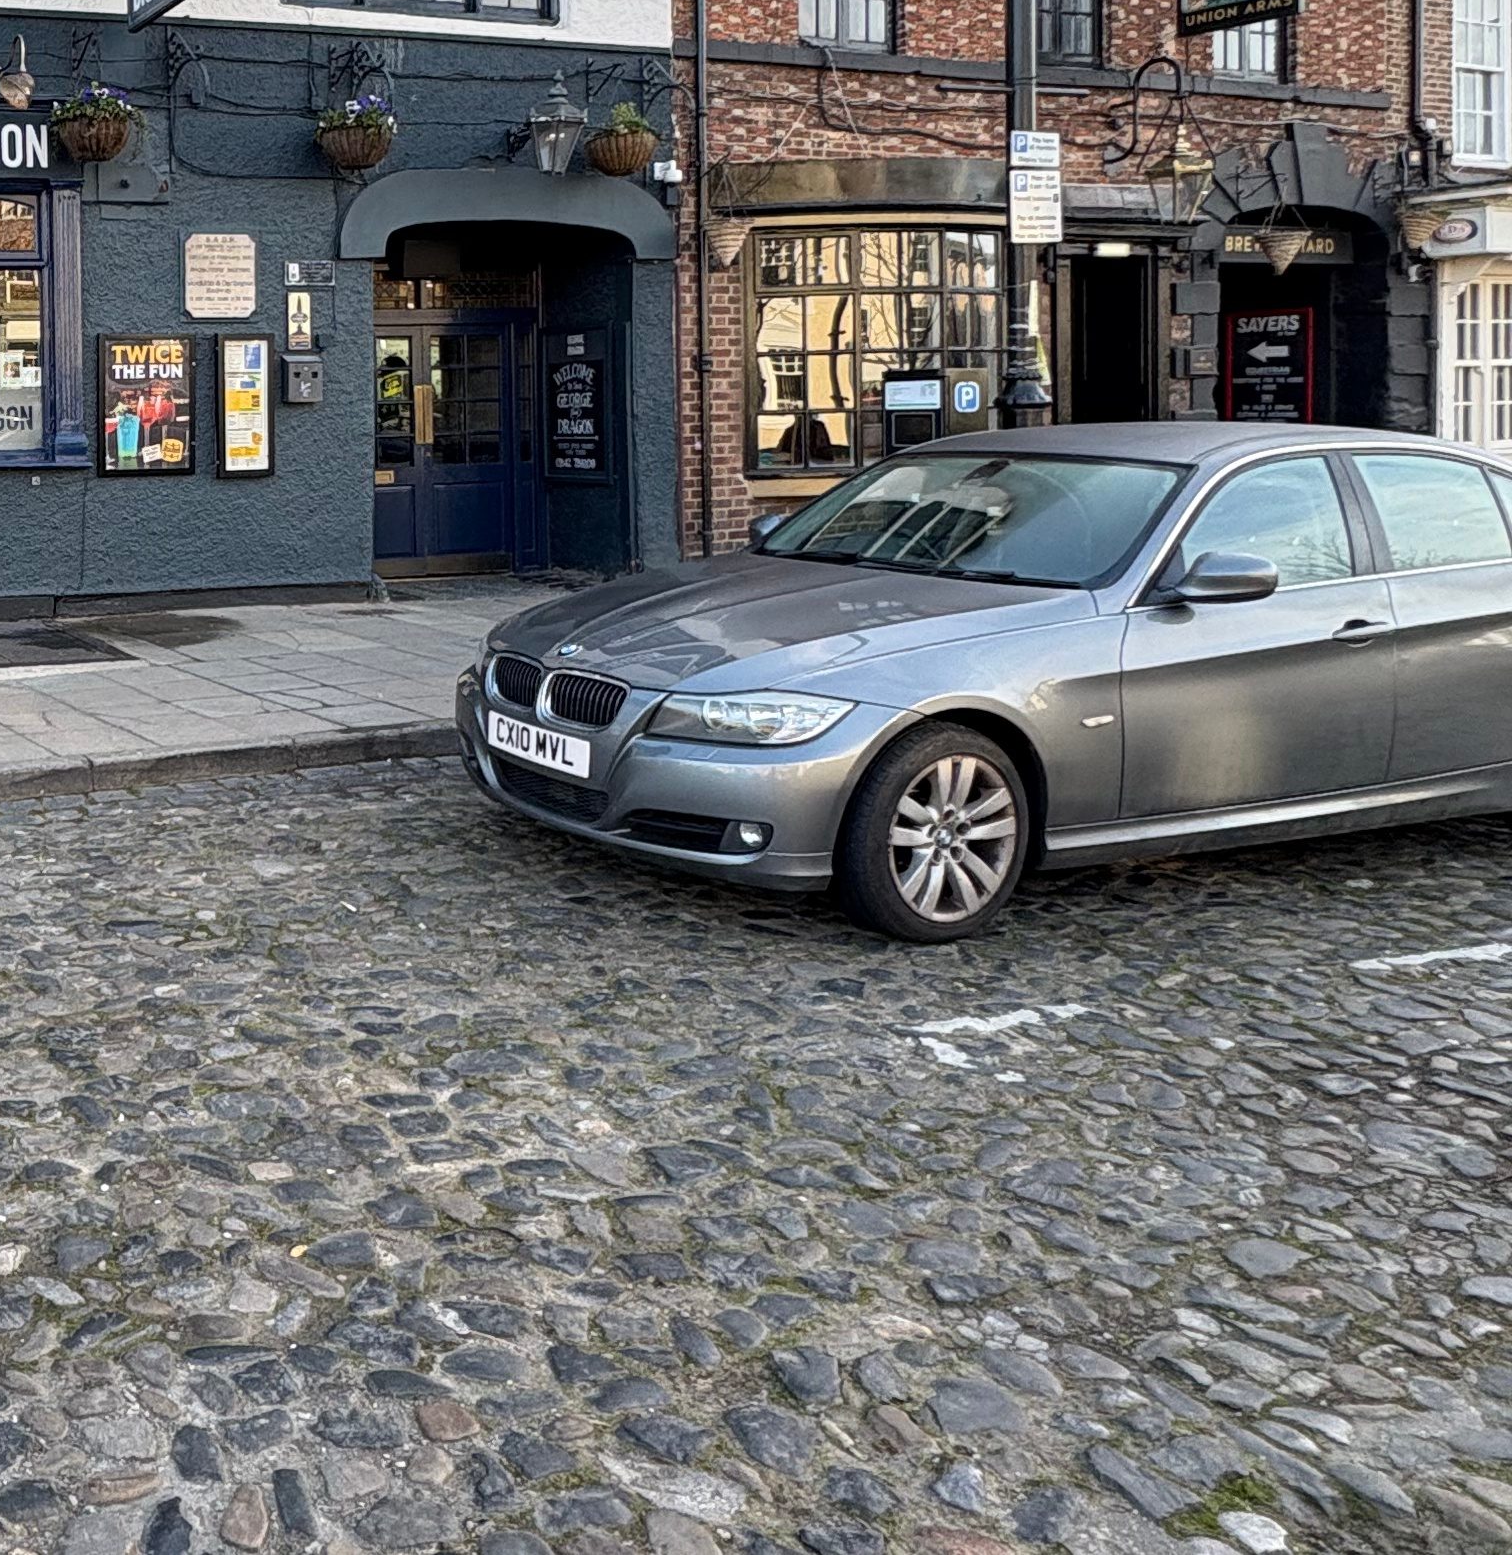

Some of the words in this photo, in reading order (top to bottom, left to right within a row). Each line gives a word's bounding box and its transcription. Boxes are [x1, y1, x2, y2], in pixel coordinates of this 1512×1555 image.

[1185, 6, 1238, 27] UNION
[1236, 315, 1300, 333] SAYERS
[111, 345, 184, 364] TWICE
[112, 364, 145, 379] THE
[149, 364, 183, 379] FUN
[553, 363, 596, 386] WELCOME
[556, 392, 594, 409] GEORGE
[557, 418, 594, 435] DRAGON
[496, 717, 530, 753] CX10
[535, 731, 574, 767] MVL
